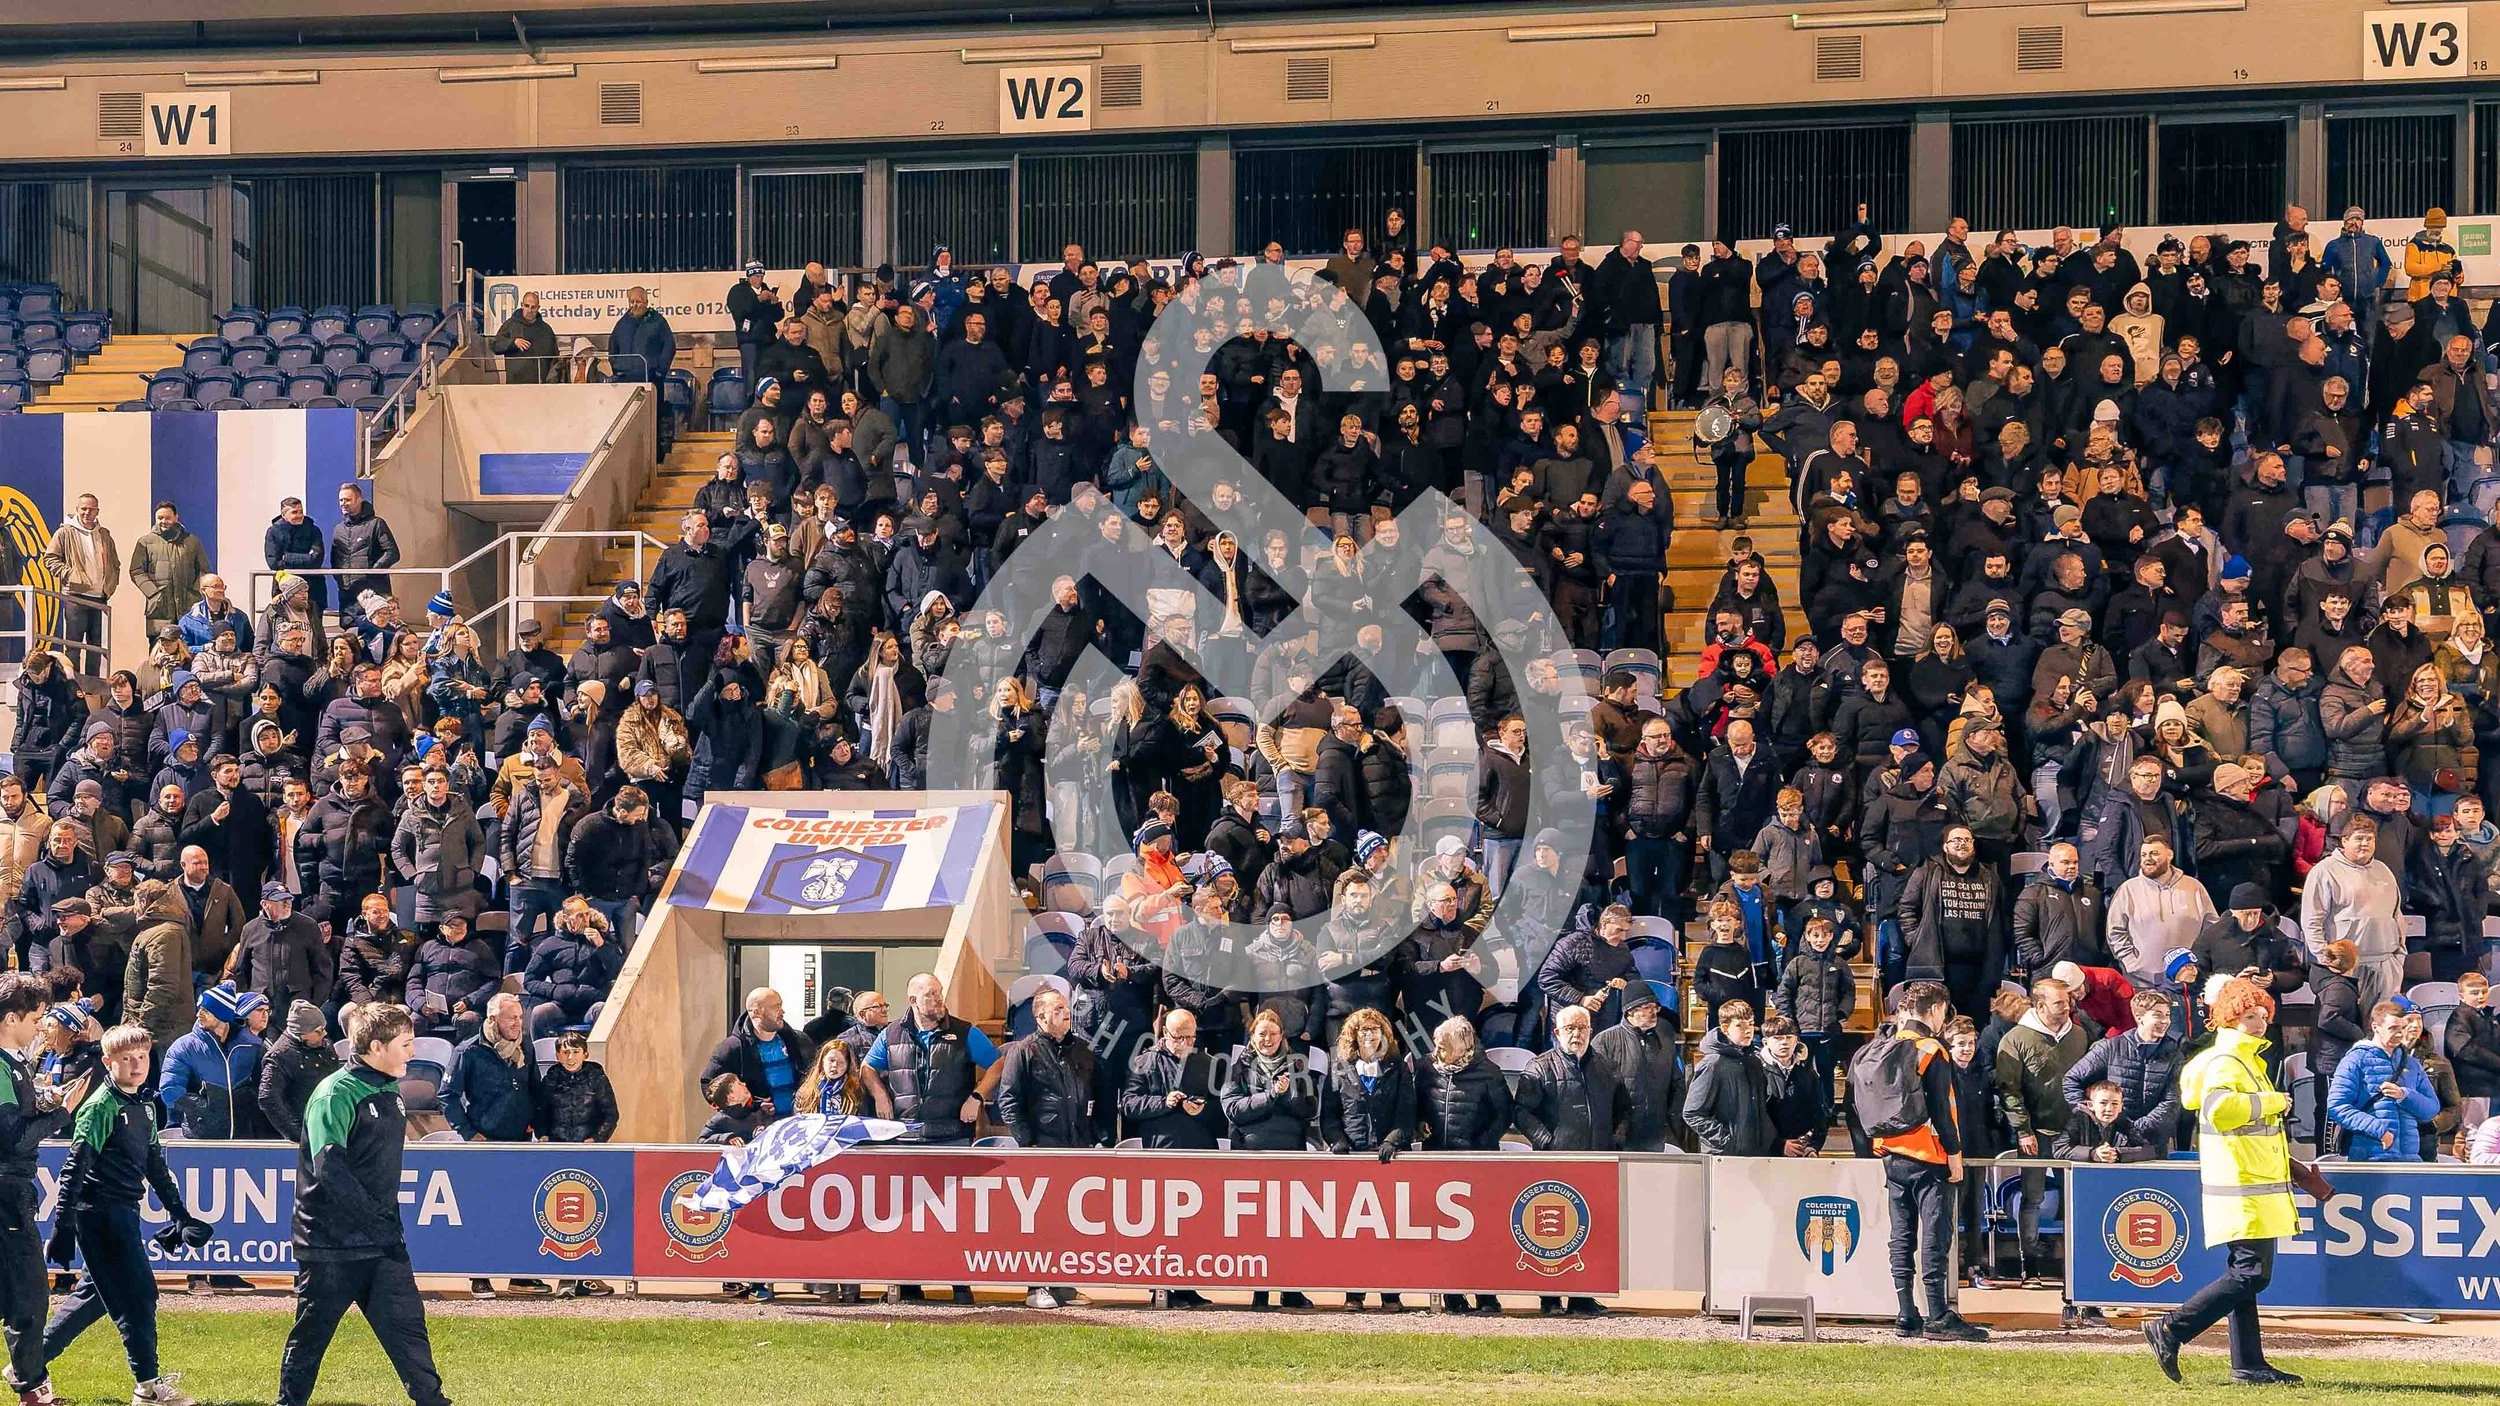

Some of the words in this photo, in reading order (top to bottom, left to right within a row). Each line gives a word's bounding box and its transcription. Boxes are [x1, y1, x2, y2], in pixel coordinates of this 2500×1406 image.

[2371, 21, 2460, 68] W3
[2473, 60, 2488, 71] 18
[1006, 77, 1084, 120] W2
[1486, 101, 1500, 110] 21
[1635, 94, 1650, 104] 20
[150, 104, 217, 146] W1
[930, 120, 944, 131] 22
[119, 142, 132, 152] 24
[534, 289, 594, 301] LCHESTER
[596, 288, 632, 299] UNIT
[541, 304, 602, 320] atchday
[753, 815, 948, 834] COLCHESTER
[786, 832, 905, 846] UNITED
[368, 1102, 379, 1118] 4
[543, 1172, 567, 1192] ESSEX
[568, 1172, 600, 1193] COUNTY
[669, 1174, 694, 1193] ESSEX
[1519, 1184, 1546, 1204] ESSEX
[1546, 1184, 1580, 1206] COUNTY
[2113, 1193, 2142, 1213] ESSEX
[2143, 1192, 2178, 1214] COUNTY
[766, 1172, 1050, 1235] COUNTY
[1067, 1176, 1204, 1238] CUP
[1223, 1178, 1476, 1242] FINALS
[1805, 1202, 1852, 1210] COLCHESTER
[536, 1210, 564, 1242] FOOTBALL
[564, 1210, 605, 1243] ASSOCIATION
[663, 1212, 691, 1243] FOOTBALL
[691, 1212, 731, 1245] ASSOCIATION
[2276, 1192, 2500, 1258] ESSEX
[1513, 1224, 1543, 1256] FOOTBALL
[1544, 1225, 1586, 1257] ASSOCIATION
[2106, 1232, 2138, 1267] FOOTBALL
[2139, 1234, 2185, 1268] ASSOCIATION
[963, 1244, 1270, 1279] www.essexfa.com
